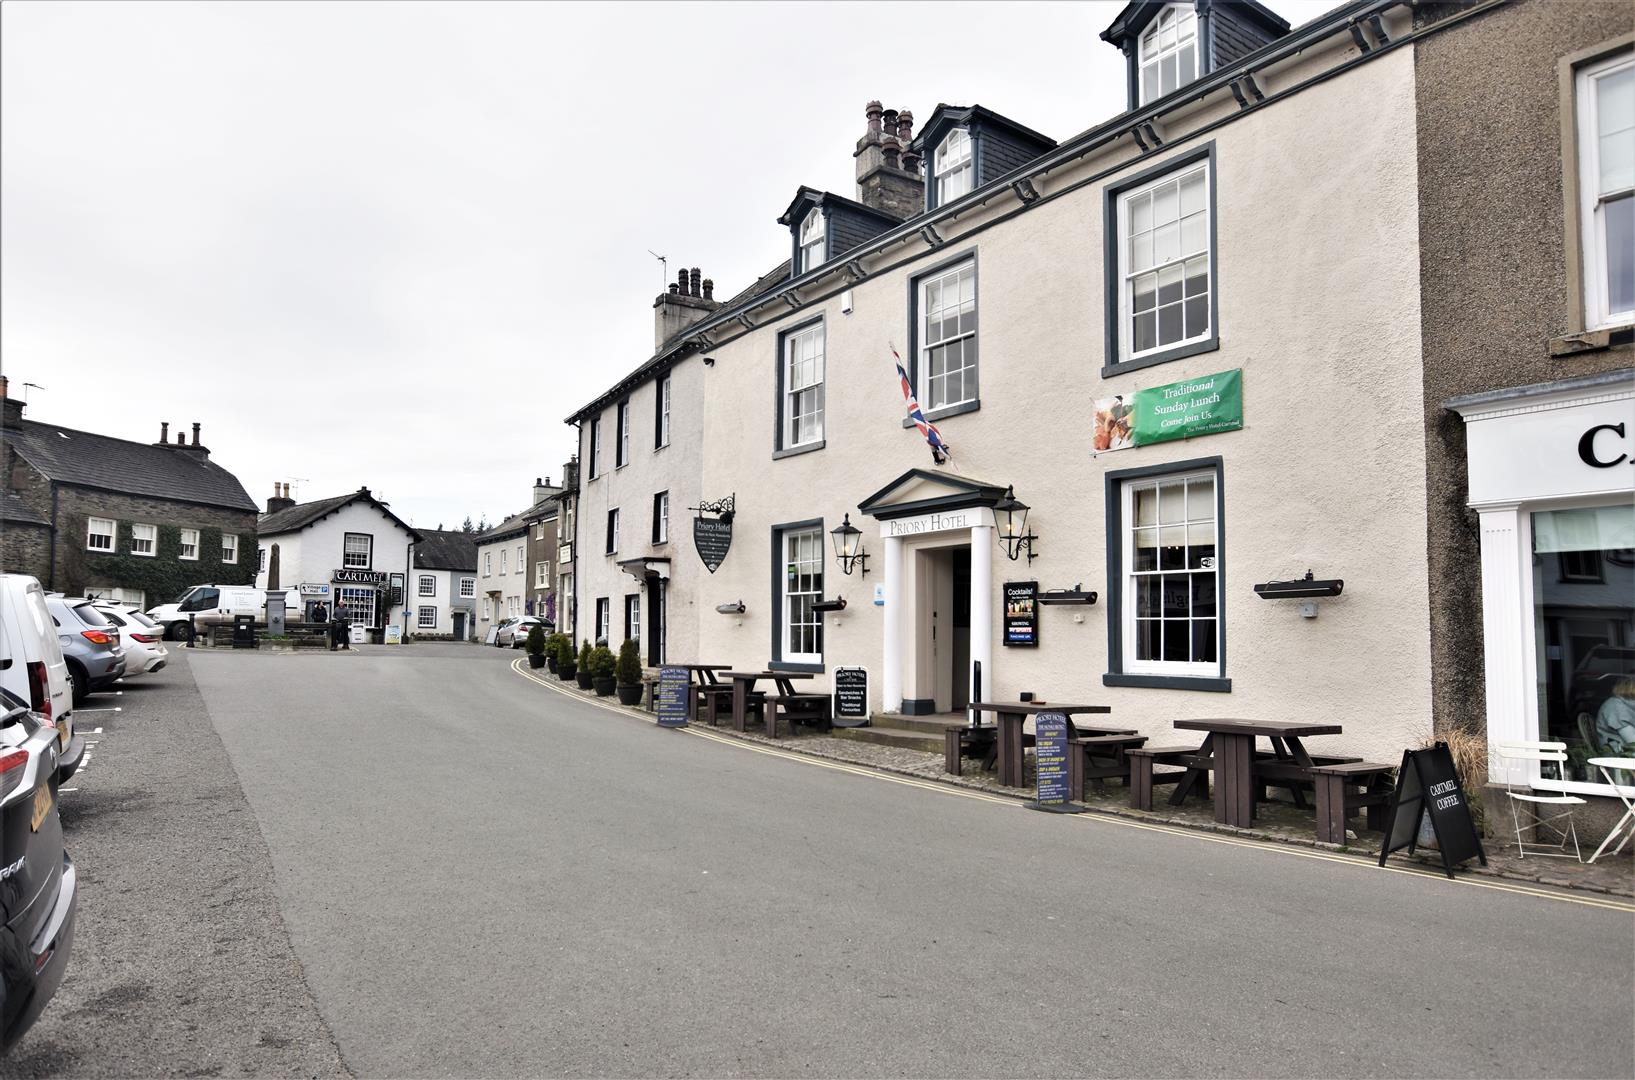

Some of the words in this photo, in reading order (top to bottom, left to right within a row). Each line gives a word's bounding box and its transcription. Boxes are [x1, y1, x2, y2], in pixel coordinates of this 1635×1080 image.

[1163, 379, 1214, 399] Traditional
[1154, 401, 1189, 415] Sunday
[1191, 392, 1220, 408] Lunch
[1161, 417, 1183, 428] Come
[1183, 414, 1199, 425] Join
[1201, 410, 1212, 420] Us
[1578, 422, 1635, 468] C
[697, 521, 714, 531] Priory
[715, 523, 731, 531] Hotel
[890, 520, 927, 536] PRIORY
[931, 515, 968, 530] HOTEL
[337, 571, 384, 583] CARTMEL
[1008, 588, 1033, 596] Cocktails!
[1036, 714, 1051, 724] PRIORY
[1053, 714, 1067, 724] HOTEL
[1429, 780, 1458, 797] CARTMEL
[1436, 795, 1459, 810] COFFEE
